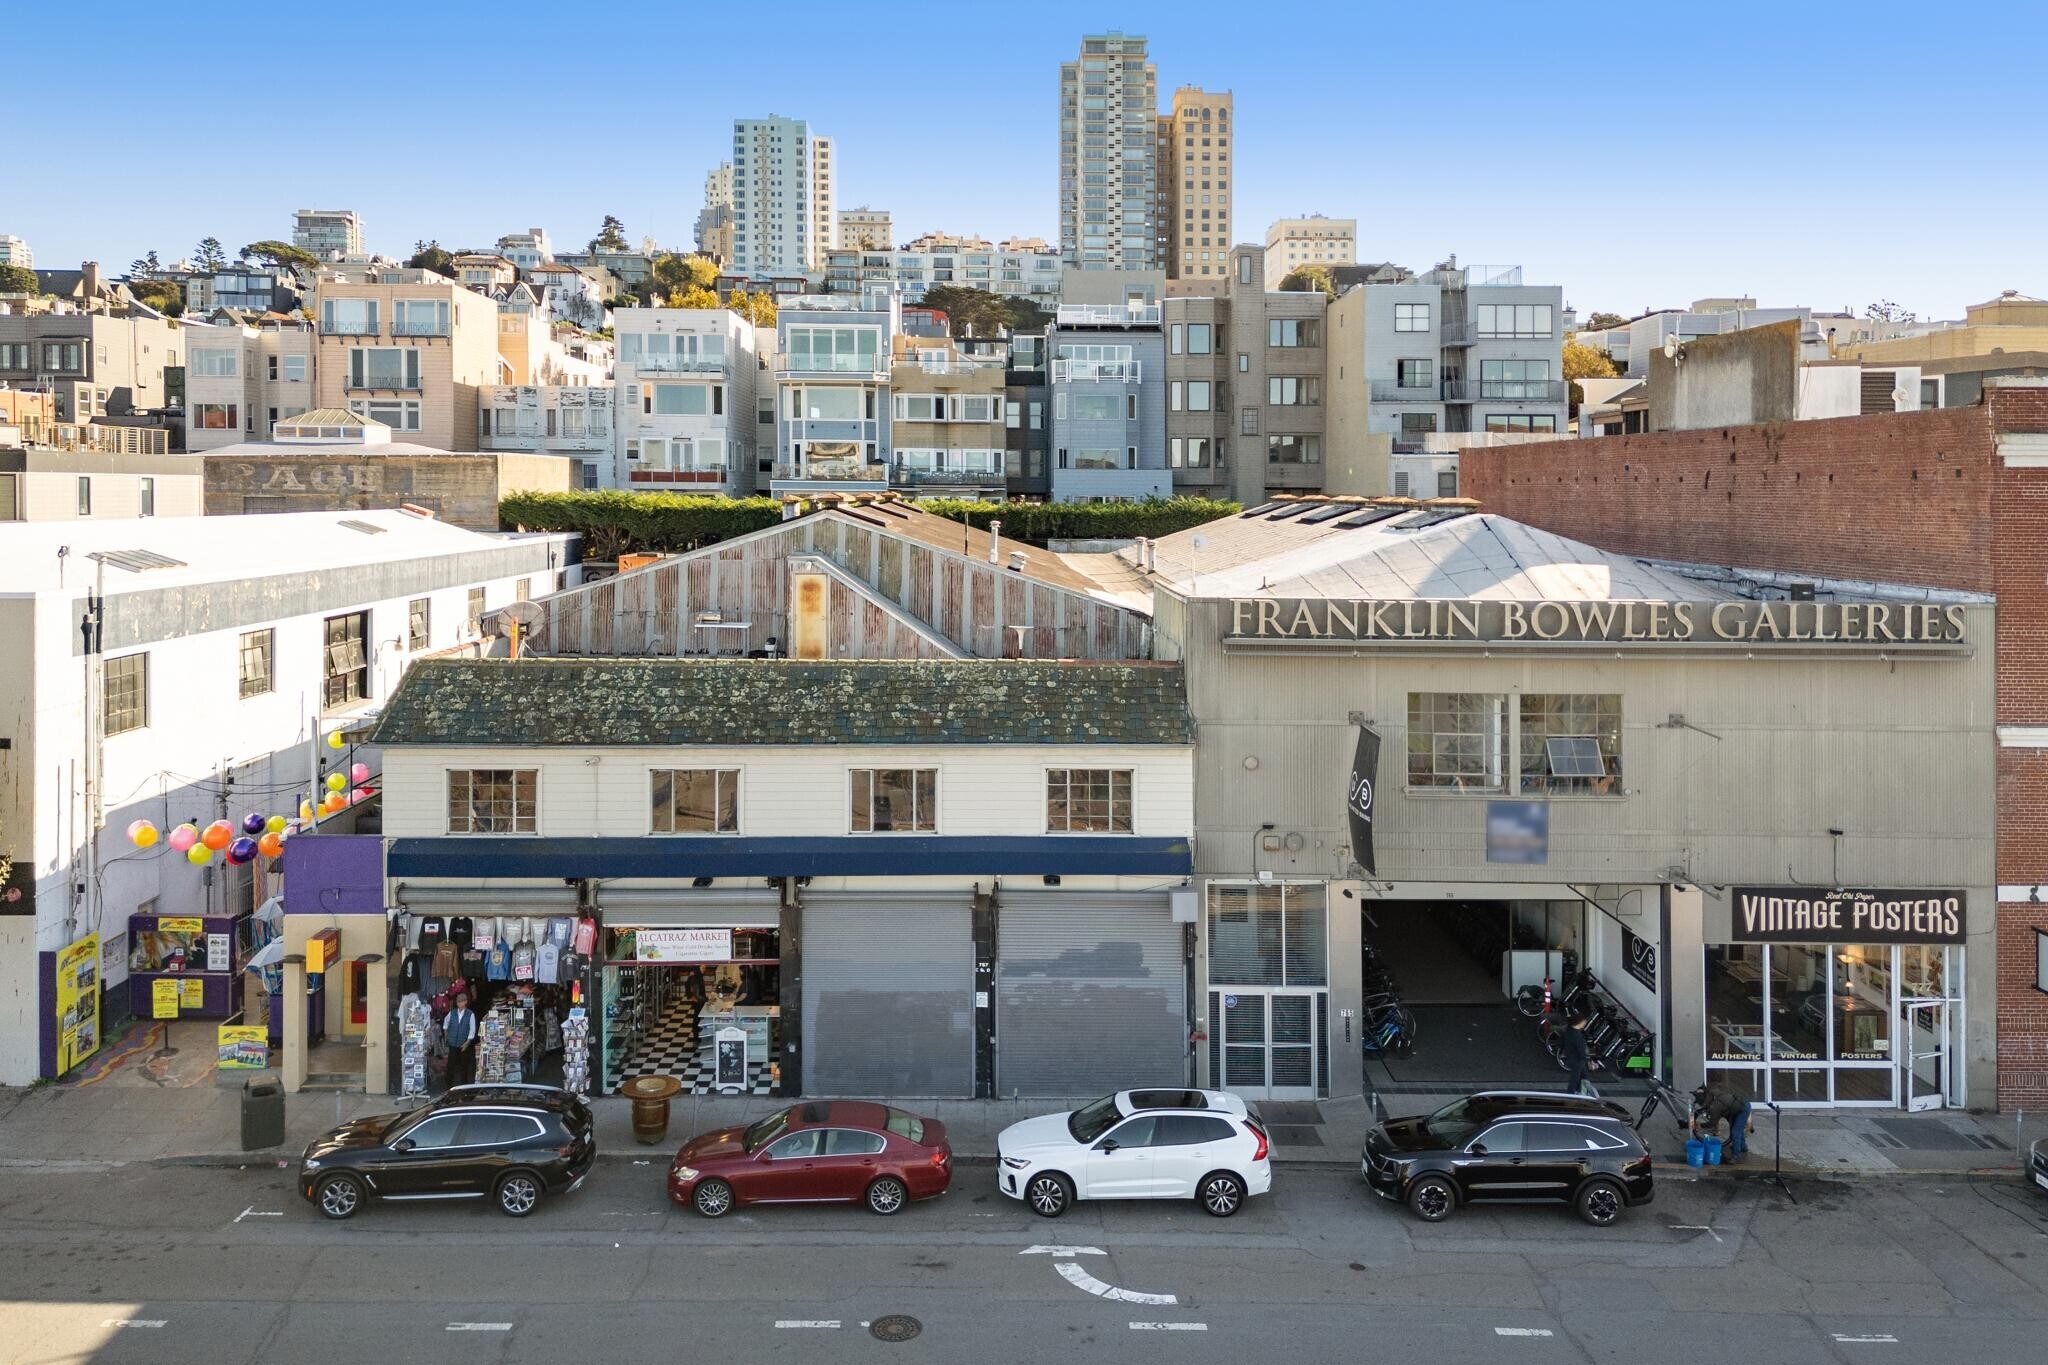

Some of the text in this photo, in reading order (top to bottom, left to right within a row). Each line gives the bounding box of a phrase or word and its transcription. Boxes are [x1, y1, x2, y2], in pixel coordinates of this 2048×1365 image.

[1229, 599, 1966, 641] FRANKLIN BOWLES GALLERIES
[1361, 787, 1369, 801] B
[1842, 892, 1854, 900] Old
[1741, 894, 1960, 935] VINTAGE POSTERS
[638, 932, 729, 943] ALCATRAZ MARKET
